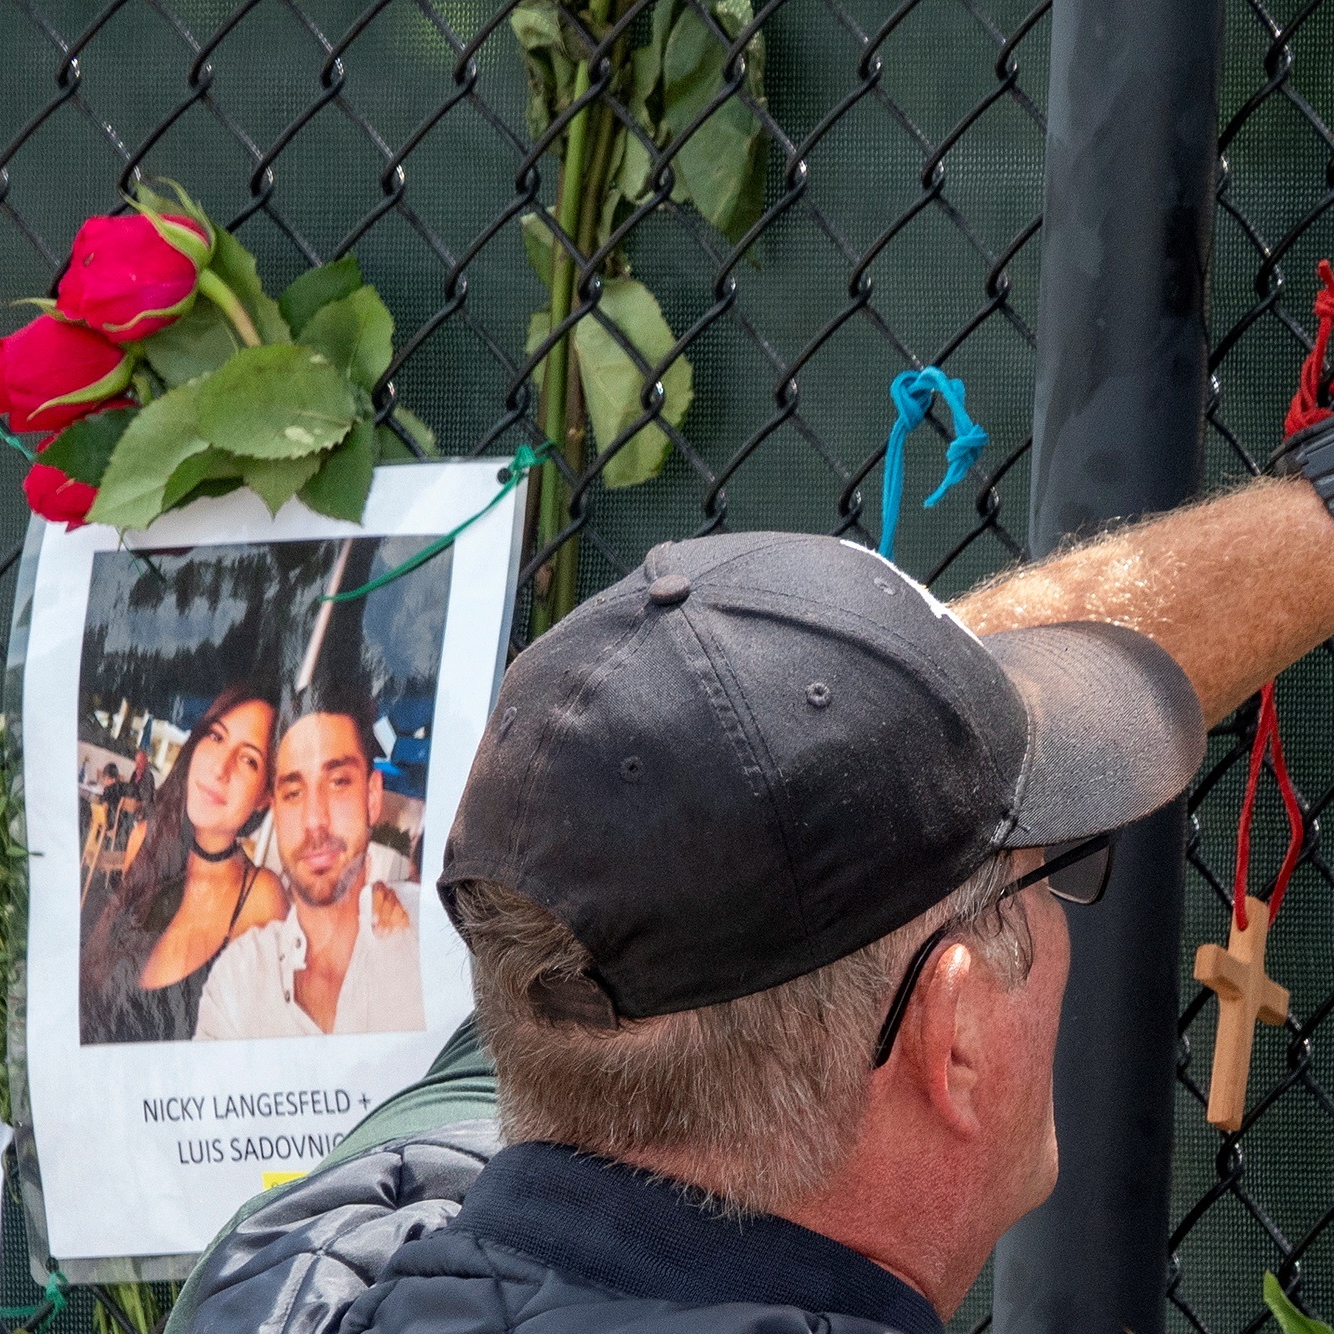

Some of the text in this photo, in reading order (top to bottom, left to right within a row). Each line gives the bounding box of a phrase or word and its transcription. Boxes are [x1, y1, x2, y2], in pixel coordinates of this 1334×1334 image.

[143, 1088, 371, 1123] NICKY LANGESFELD +
[177, 1138, 224, 1165] LUIS
